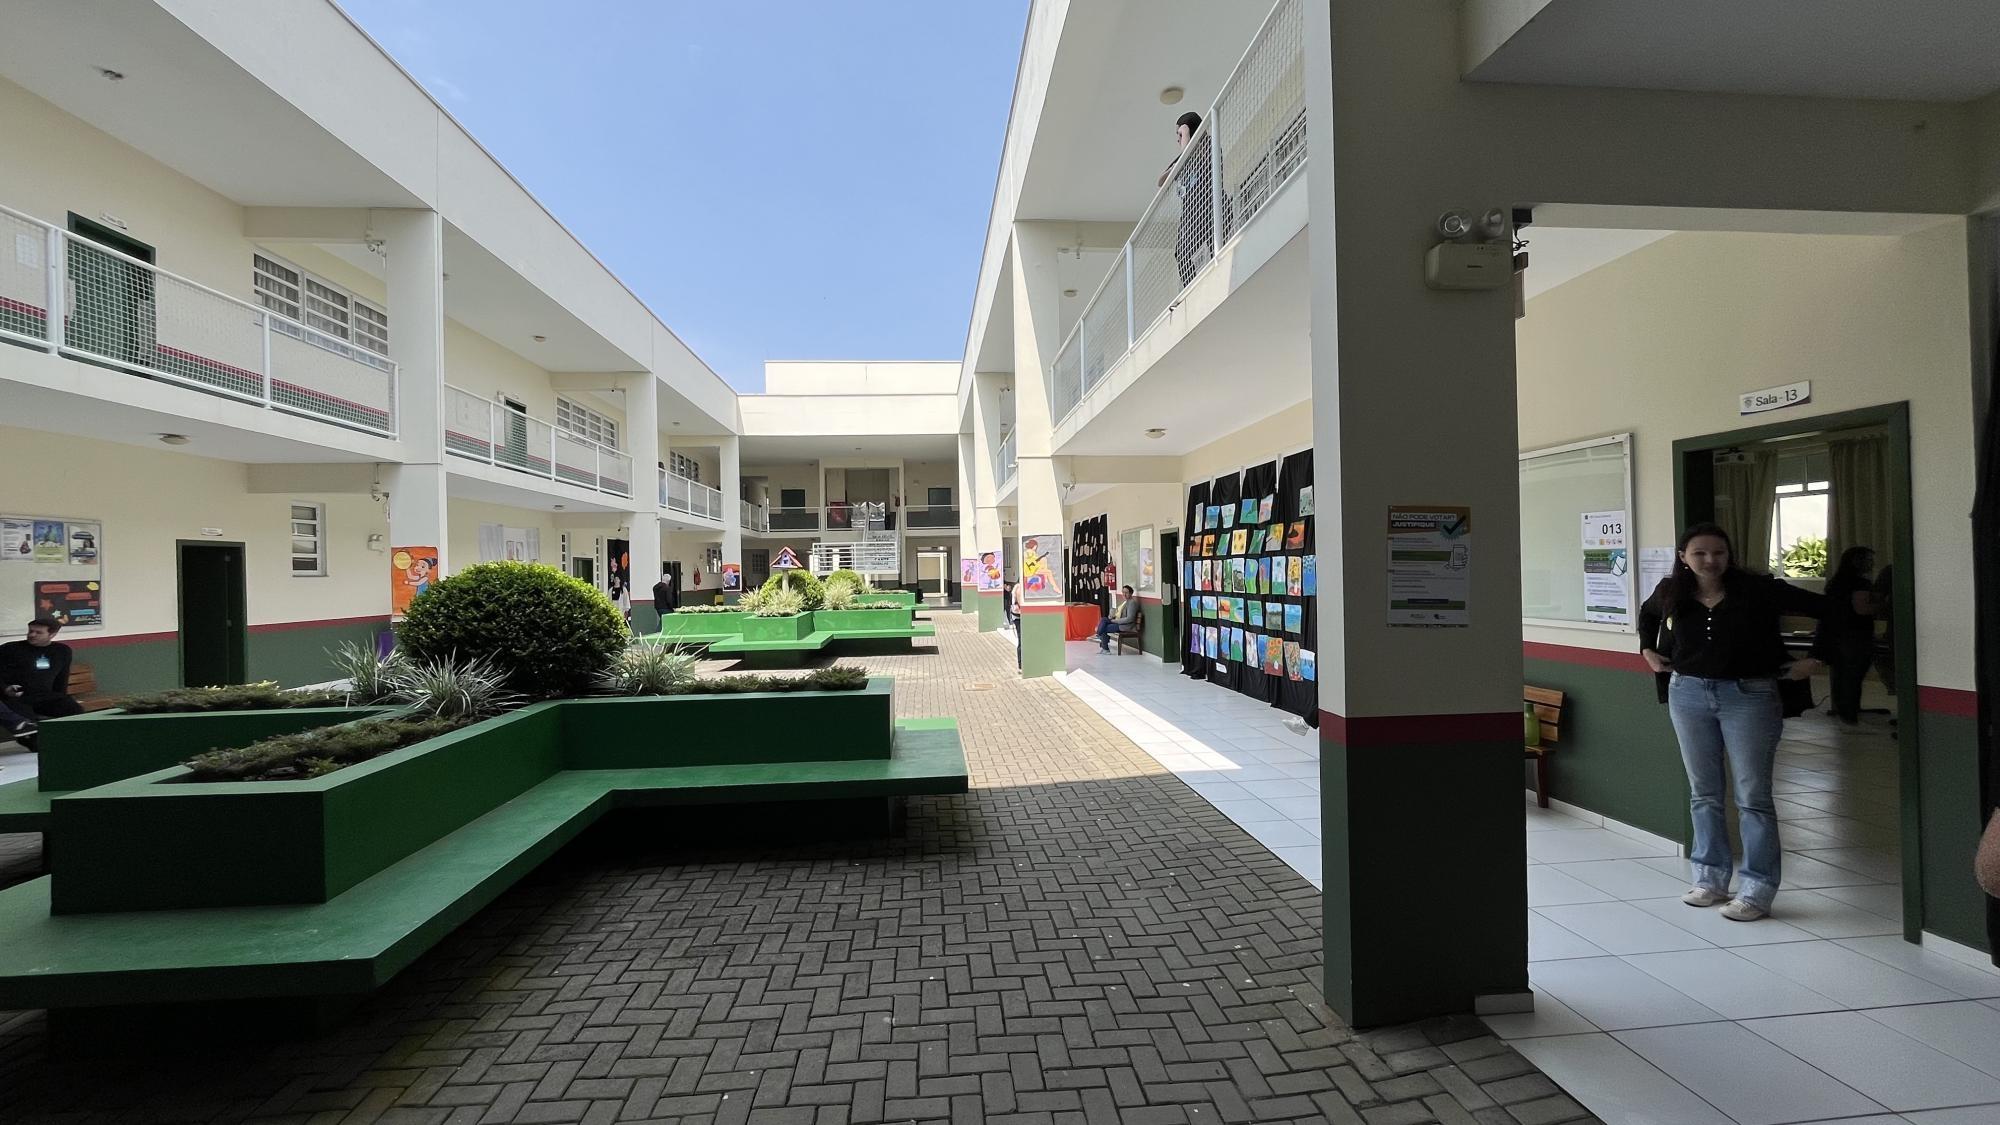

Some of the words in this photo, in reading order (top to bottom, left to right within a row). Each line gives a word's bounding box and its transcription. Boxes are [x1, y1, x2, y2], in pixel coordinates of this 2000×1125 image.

[1755, 394, 1777, 406] Sala
[1785, 389, 1798, 401] 13
[1602, 523, 1622, 535] 013
